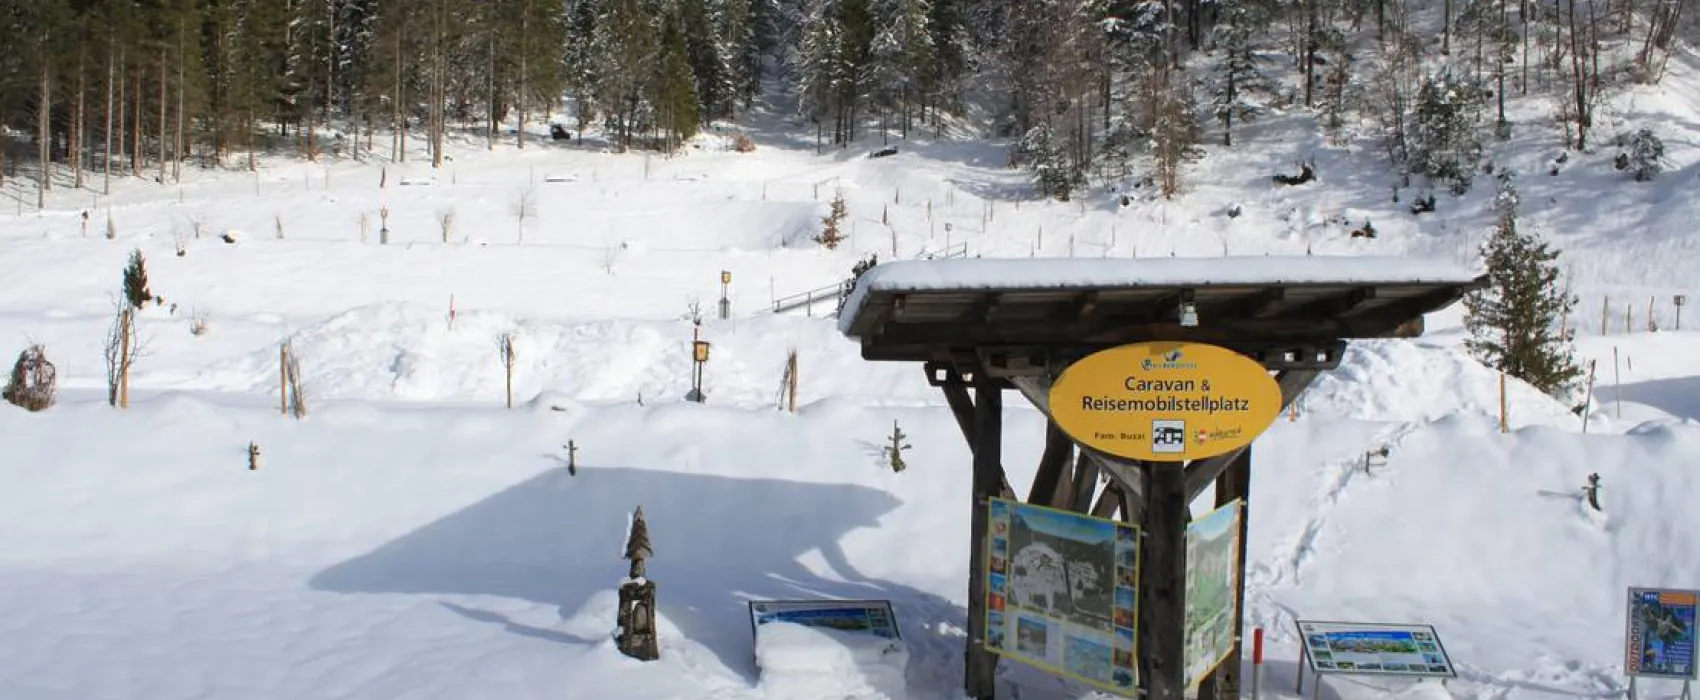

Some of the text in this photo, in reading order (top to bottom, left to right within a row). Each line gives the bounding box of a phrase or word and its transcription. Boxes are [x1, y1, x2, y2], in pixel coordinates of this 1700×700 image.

[1124, 376, 1211, 391] Caravan &
[1082, 396, 1249, 414] Reisemobilstellplatz
[1094, 432, 1117, 440] Fam.
